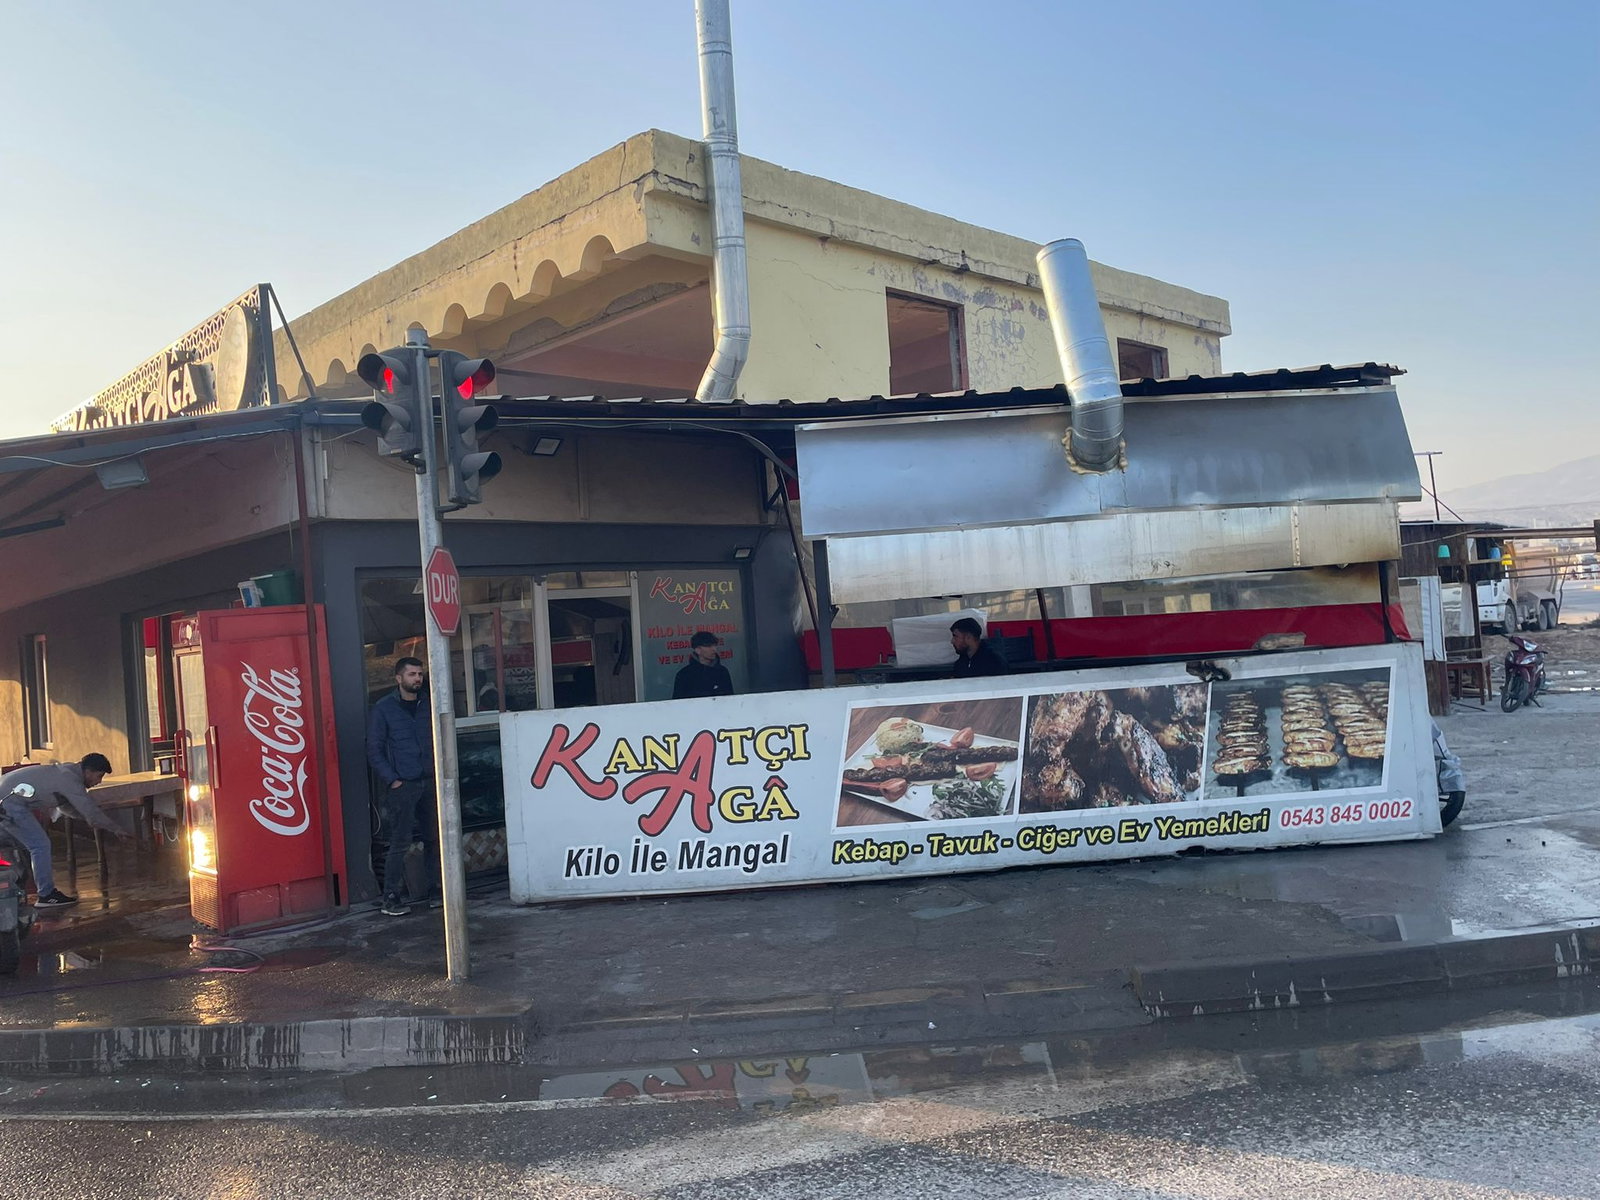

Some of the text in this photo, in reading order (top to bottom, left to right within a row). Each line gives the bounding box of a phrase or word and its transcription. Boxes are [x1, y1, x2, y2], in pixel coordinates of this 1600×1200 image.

[431, 572, 459, 606] DUR
[531, 722, 810, 822] KANATÇI
[564, 834, 789, 877] Kilo İle Mangal
[832, 838, 908, 864] Kebap
[928, 831, 1000, 856] Tavuk
[1016, 825, 1081, 853] Ciğer
[1085, 824, 1114, 844] ve
[1117, 819, 1152, 843] Ev
[1153, 808, 1270, 840] Yemekleri
[1280, 806, 1325, 827] 0543
[1330, 803, 1363, 824] 845
[1368, 800, 1412, 820] 0002
